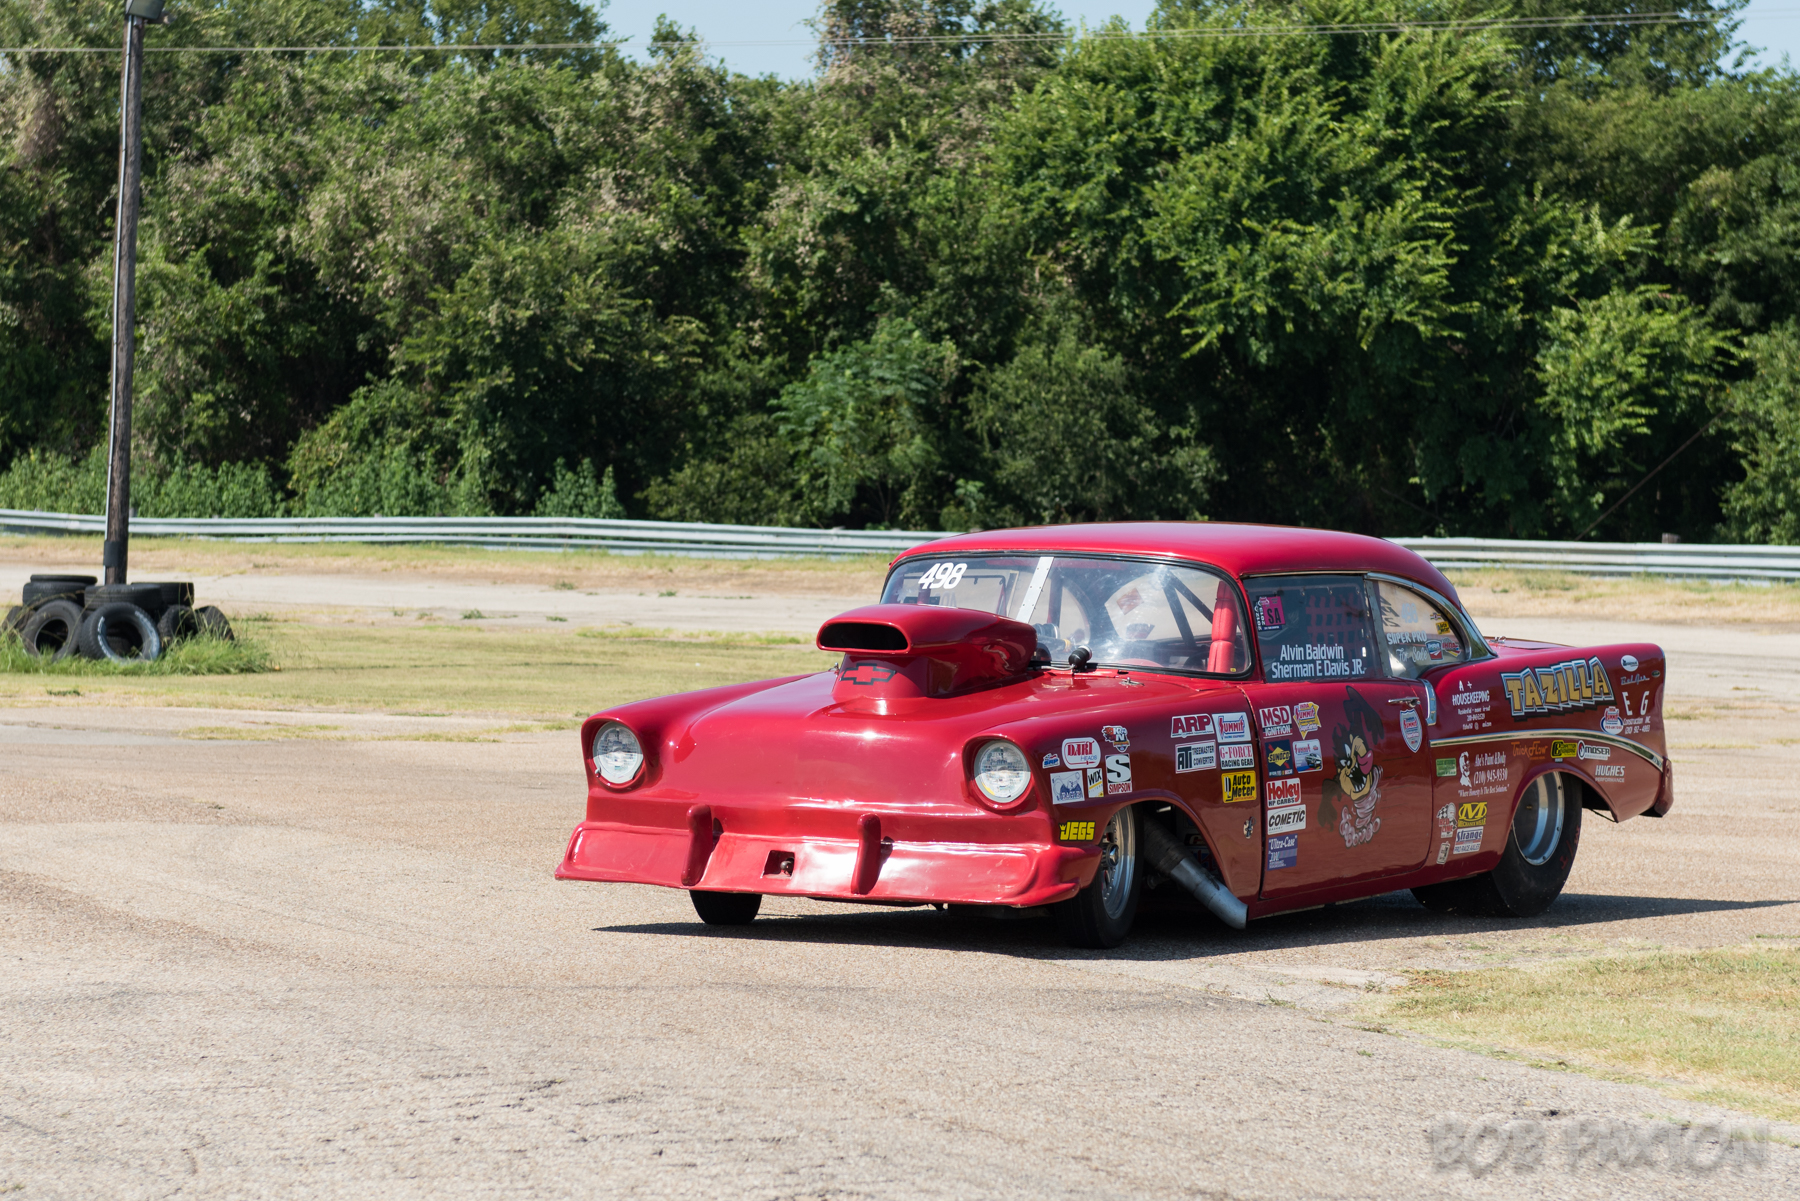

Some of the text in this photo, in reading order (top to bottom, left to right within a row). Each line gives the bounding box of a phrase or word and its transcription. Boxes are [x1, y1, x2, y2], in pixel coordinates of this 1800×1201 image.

[918, 562, 967, 589] 498
[1267, 608, 1282, 625] SA
[1401, 603, 1419, 624] 498
[1386, 630, 1427, 645] SUPER PRO
[1280, 643, 1344, 661] Alvin Baldwin
[1396, 646, 1427, 662] For Sale
[1271, 661, 1315, 678] Sherman
[1316, 661, 1325, 676] E
[1324, 660, 1350, 676] Davis
[1458, 680, 1464, 691] A
[1501, 656, 1616, 717] TAZILLA
[1452, 690, 1490, 706] HOUSEKEEPING
[1622, 690, 1650, 716] E G
[1172, 715, 1211, 734] ARP
[1261, 706, 1290, 727] MSD
[1265, 725, 1291, 737] IGNITION
[1067, 741, 1095, 757] DART
[1220, 745, 1253, 759] G-FORCE
[1268, 751, 1291, 761] SUNOCO
[1105, 754, 1132, 783] S
[1193, 756, 1214, 767] CONVERTER
[1221, 758, 1254, 768] RACING GEAR
[1087, 769, 1103, 786] WIX
[1595, 765, 1626, 777] HUGHES
[1232, 773, 1252, 787] Auto
[1108, 783, 1131, 794] SIMPSON
[1231, 786, 1256, 799] Meter
[1268, 781, 1300, 802] Holley
[1277, 798, 1295, 806] CARBS
[1268, 810, 1306, 828] COMETIC
[1059, 821, 1096, 841] JEGS
[1456, 829, 1482, 843] Strange
